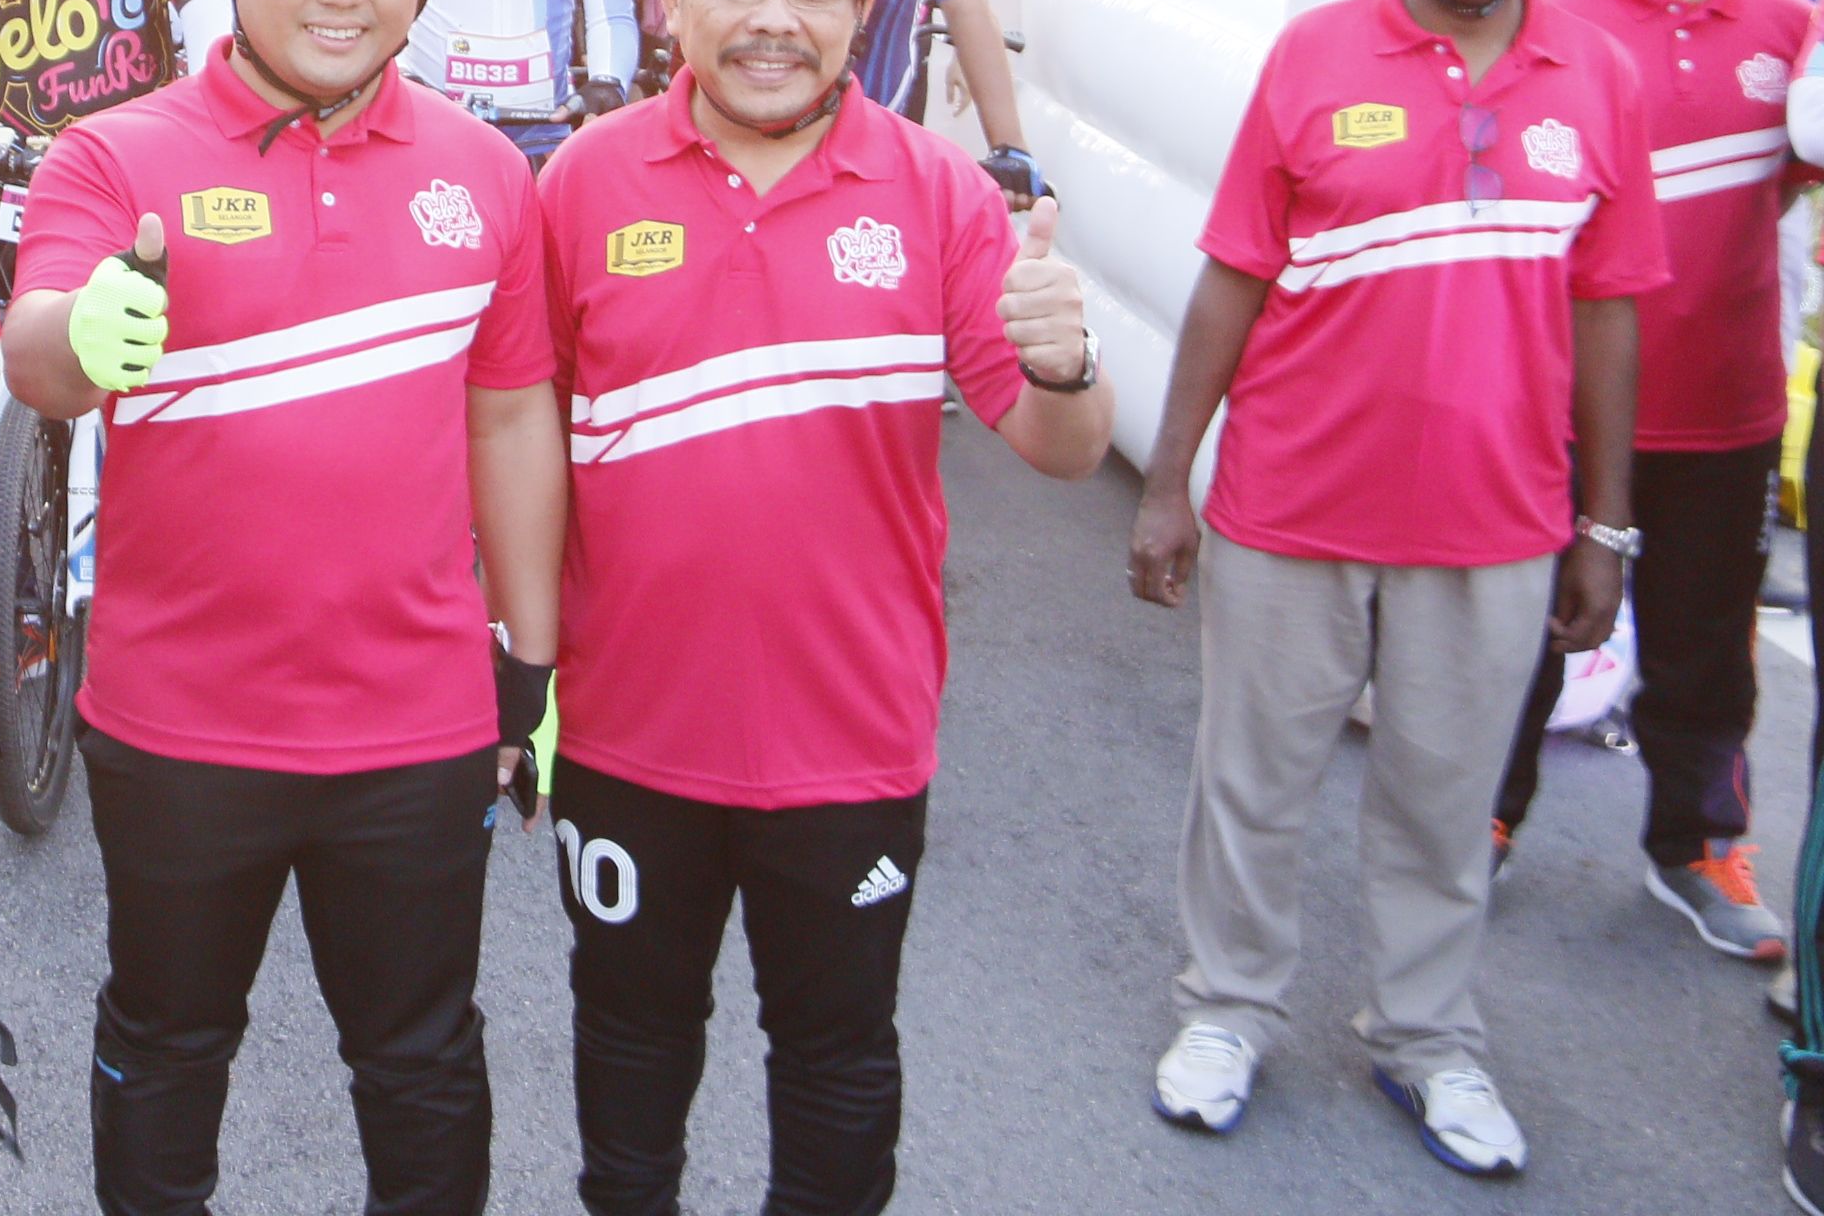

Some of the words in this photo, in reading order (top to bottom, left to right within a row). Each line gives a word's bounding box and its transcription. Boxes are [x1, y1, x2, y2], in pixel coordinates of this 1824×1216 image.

[450, 60, 518, 82] B1632
[1355, 111, 1393, 123] JKR
[212, 198, 257, 212] JKR
[631, 230, 673, 246] JKR
